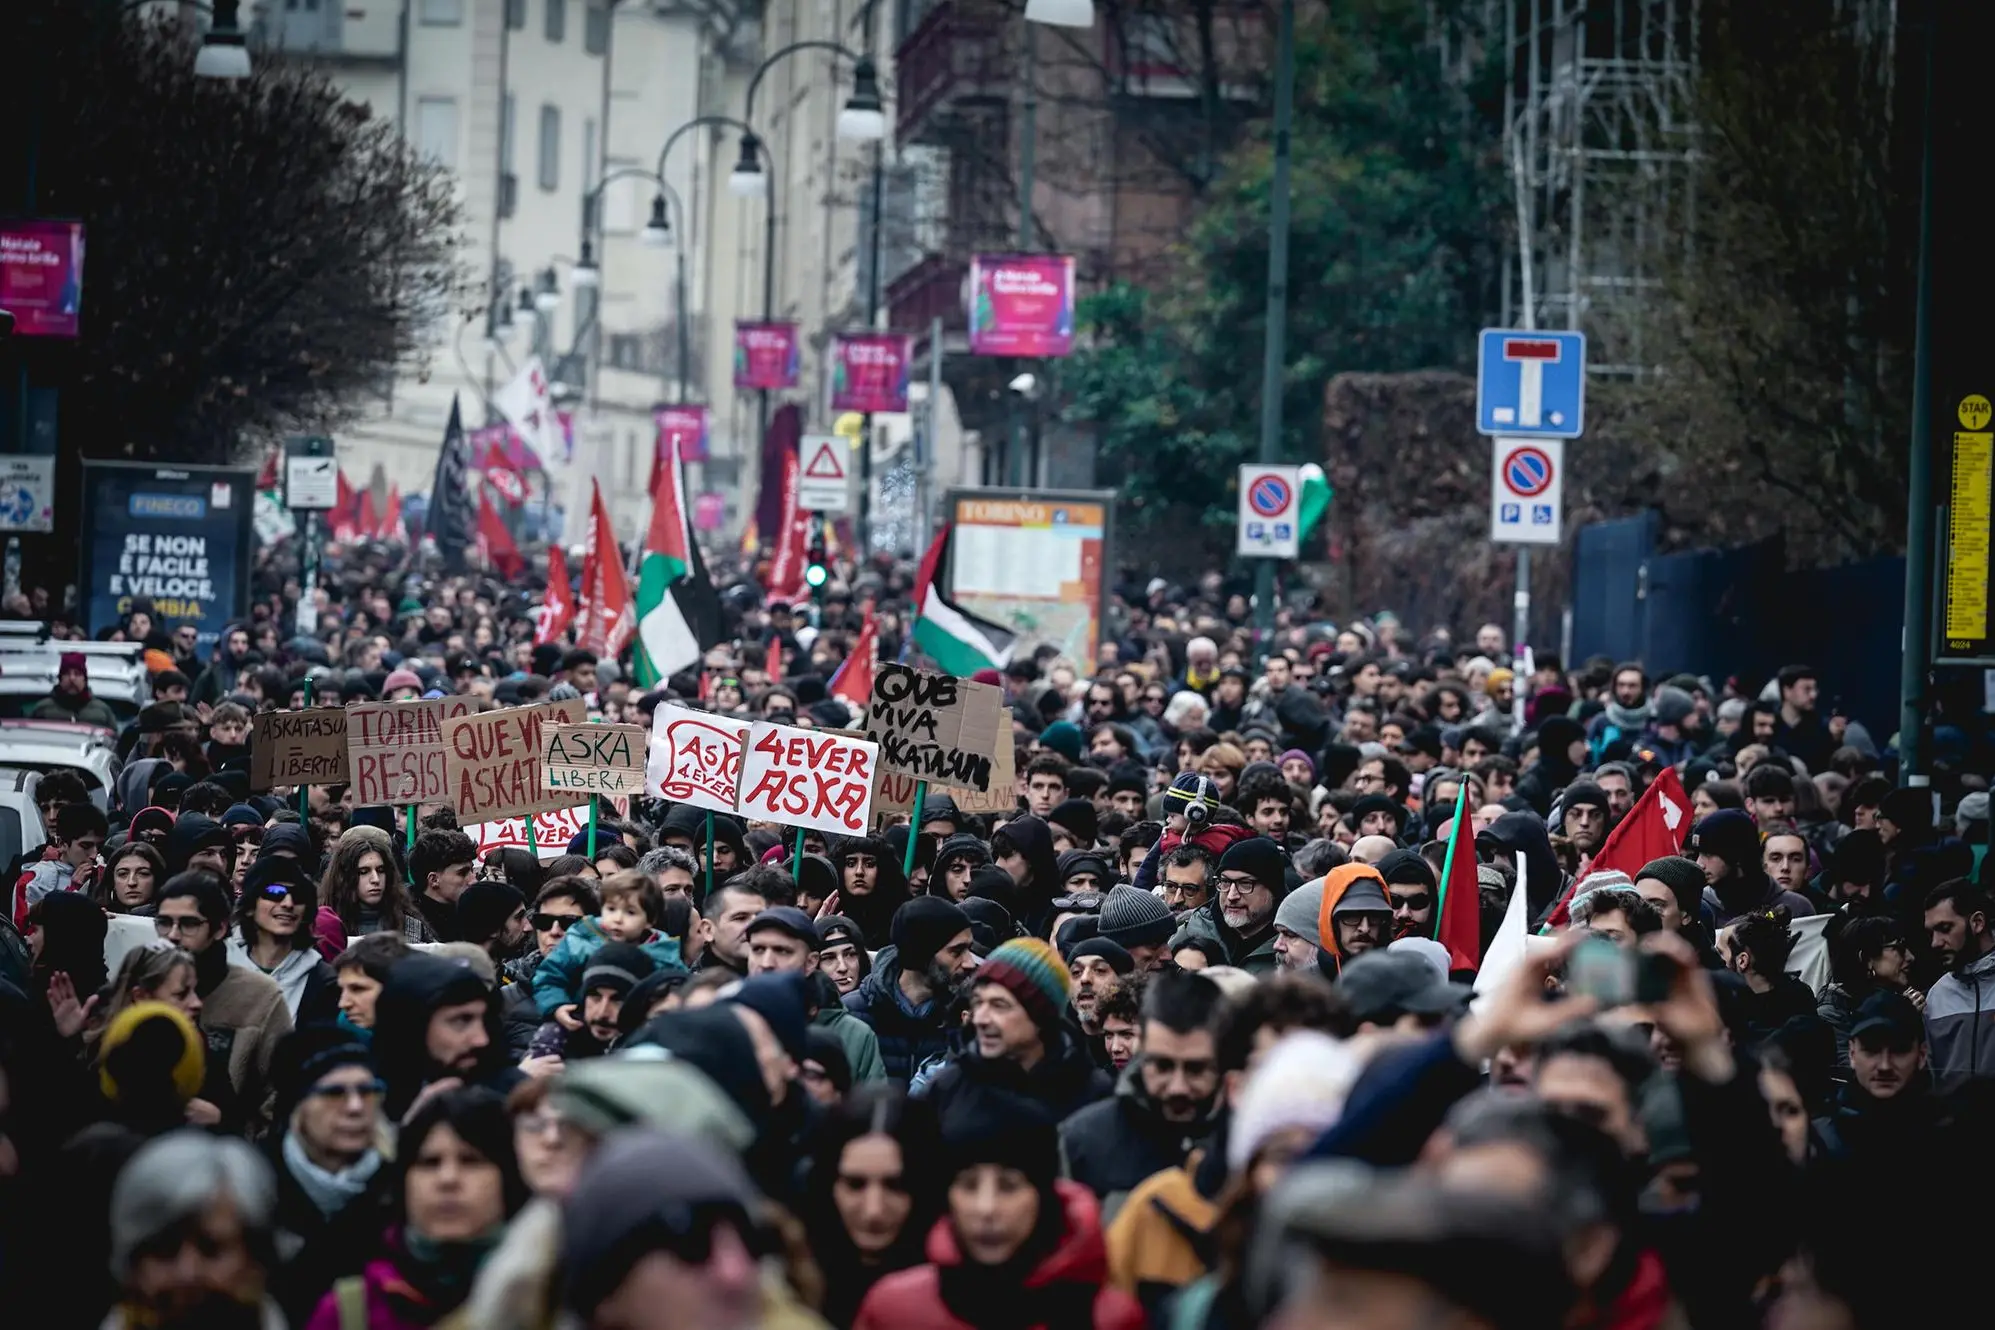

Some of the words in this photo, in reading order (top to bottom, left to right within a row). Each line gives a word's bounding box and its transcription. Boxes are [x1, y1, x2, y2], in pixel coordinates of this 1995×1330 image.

[1961, 403, 1989, 413] STAR
[135, 497, 200, 514] FINECO
[125, 534, 150, 554] SE
[154, 536, 206, 555] NON
[137, 555, 209, 578] FACILE
[110, 575, 123, 594] E
[128, 576, 216, 601] VELOCE,
[117, 597, 206, 620] CMBIA.
[1950, 641, 1971, 649] 4024
[874, 663, 959, 707] QUE
[260, 718, 348, 742] ASKATASU
[872, 702, 937, 740] VIVA
[452, 720, 514, 762] QUE
[547, 731, 631, 767] ASKA
[754, 728, 869, 779] 4EVER
[549, 767, 624, 790] LIBERA
[745, 769, 867, 830] ASKA
